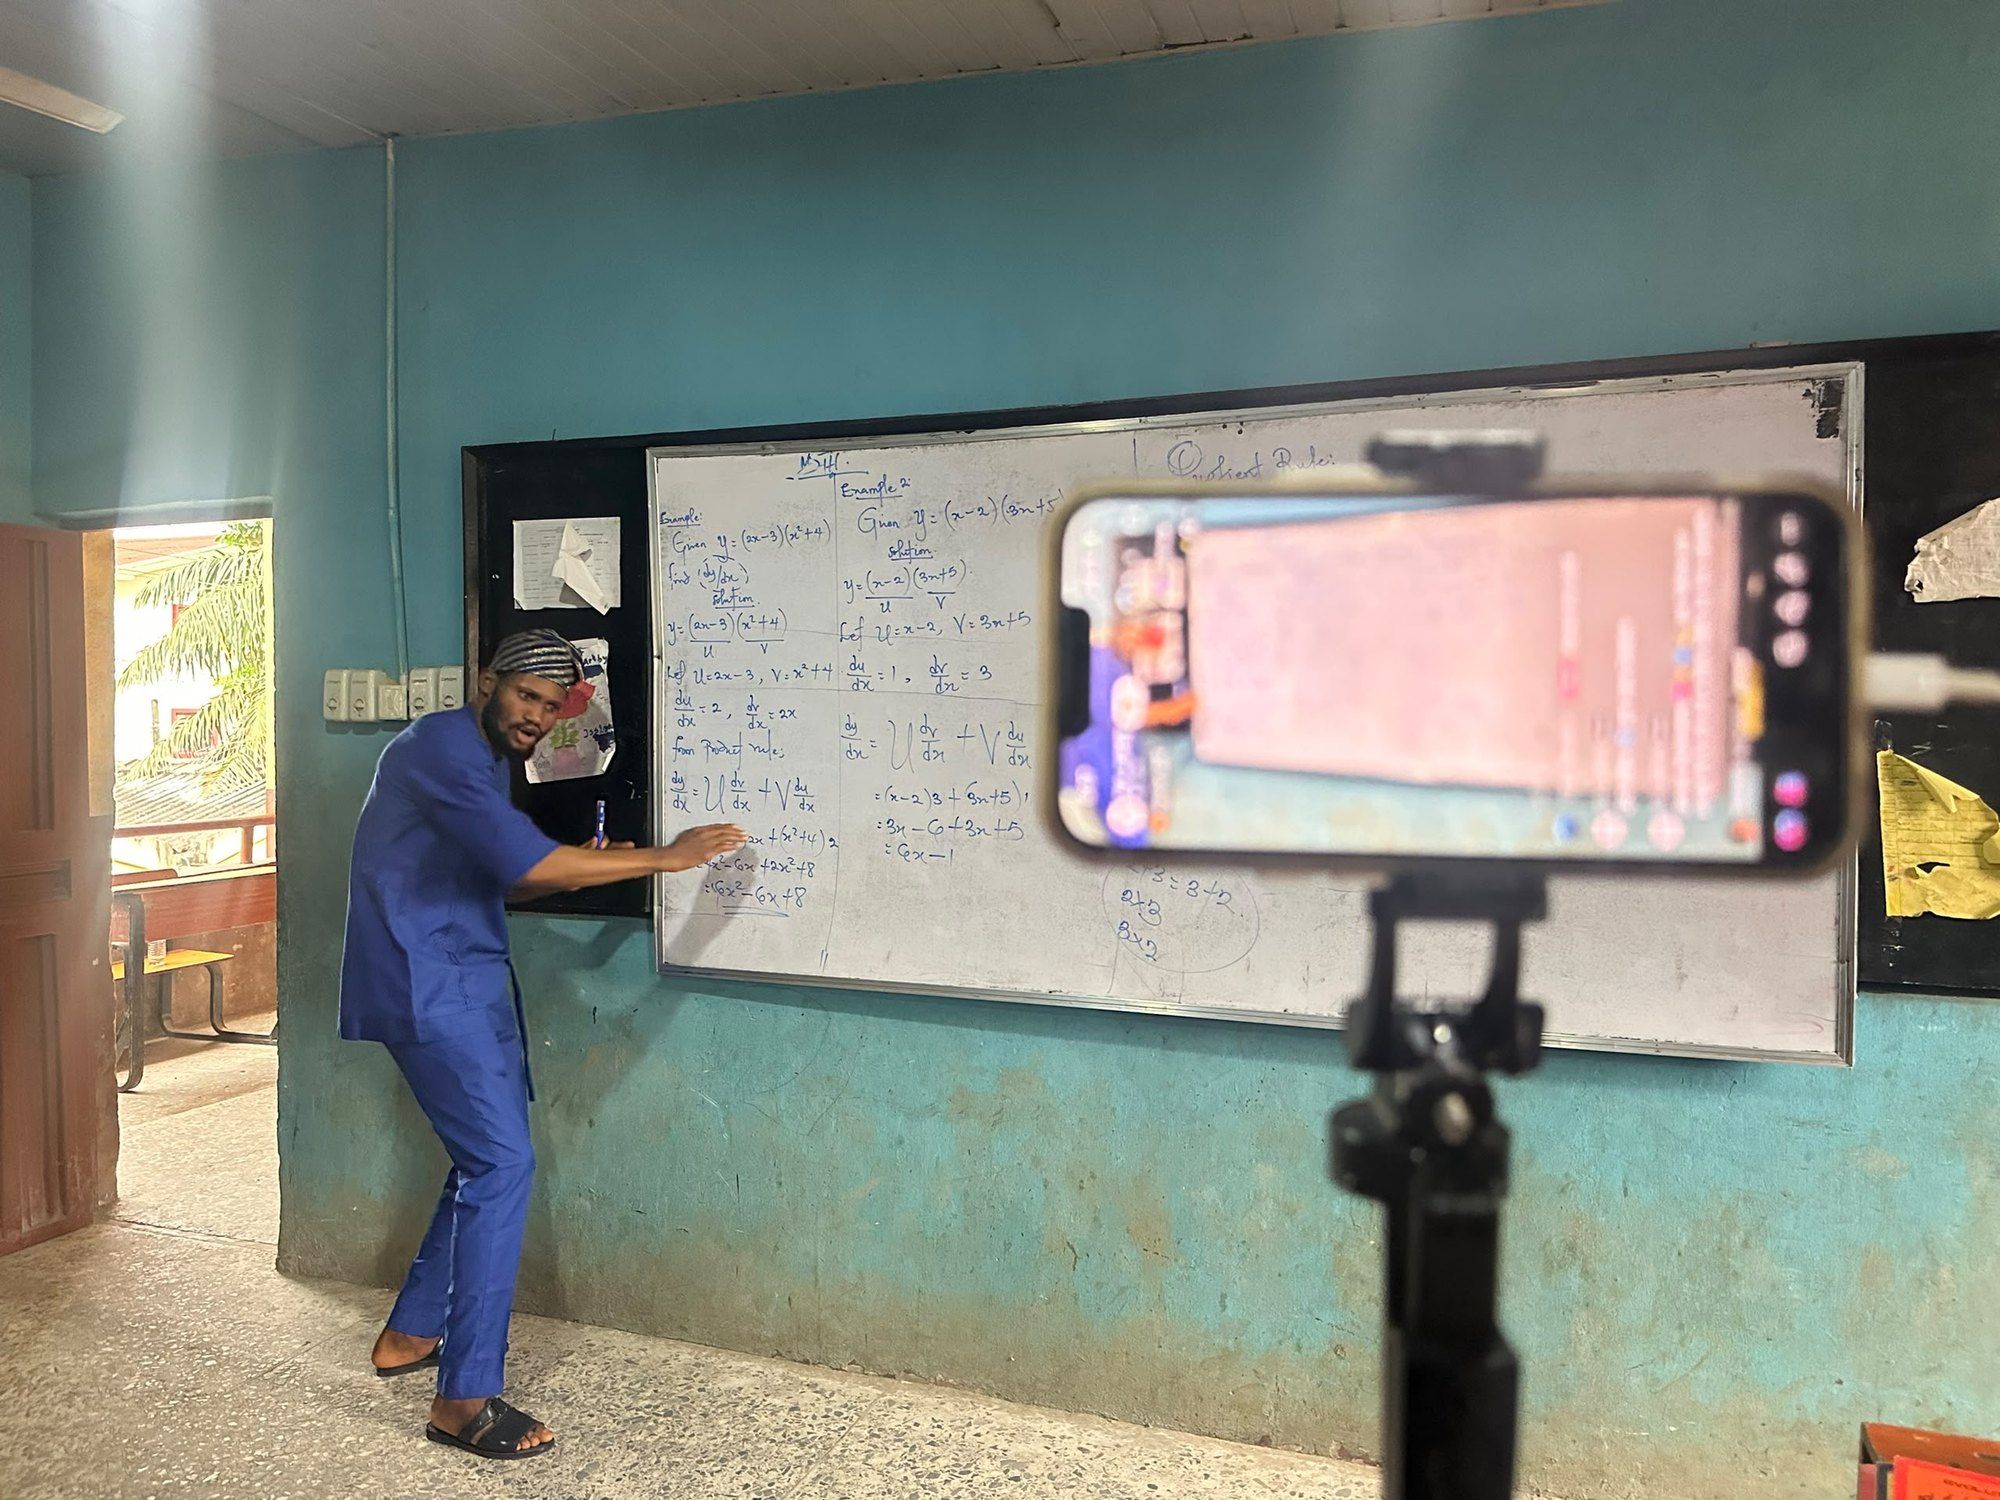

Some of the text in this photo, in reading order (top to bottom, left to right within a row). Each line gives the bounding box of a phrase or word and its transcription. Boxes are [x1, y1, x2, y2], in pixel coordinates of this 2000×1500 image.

[841, 474, 897, 507] Example
[857, 507, 900, 540] Given
[672, 530, 707, 566] Given
